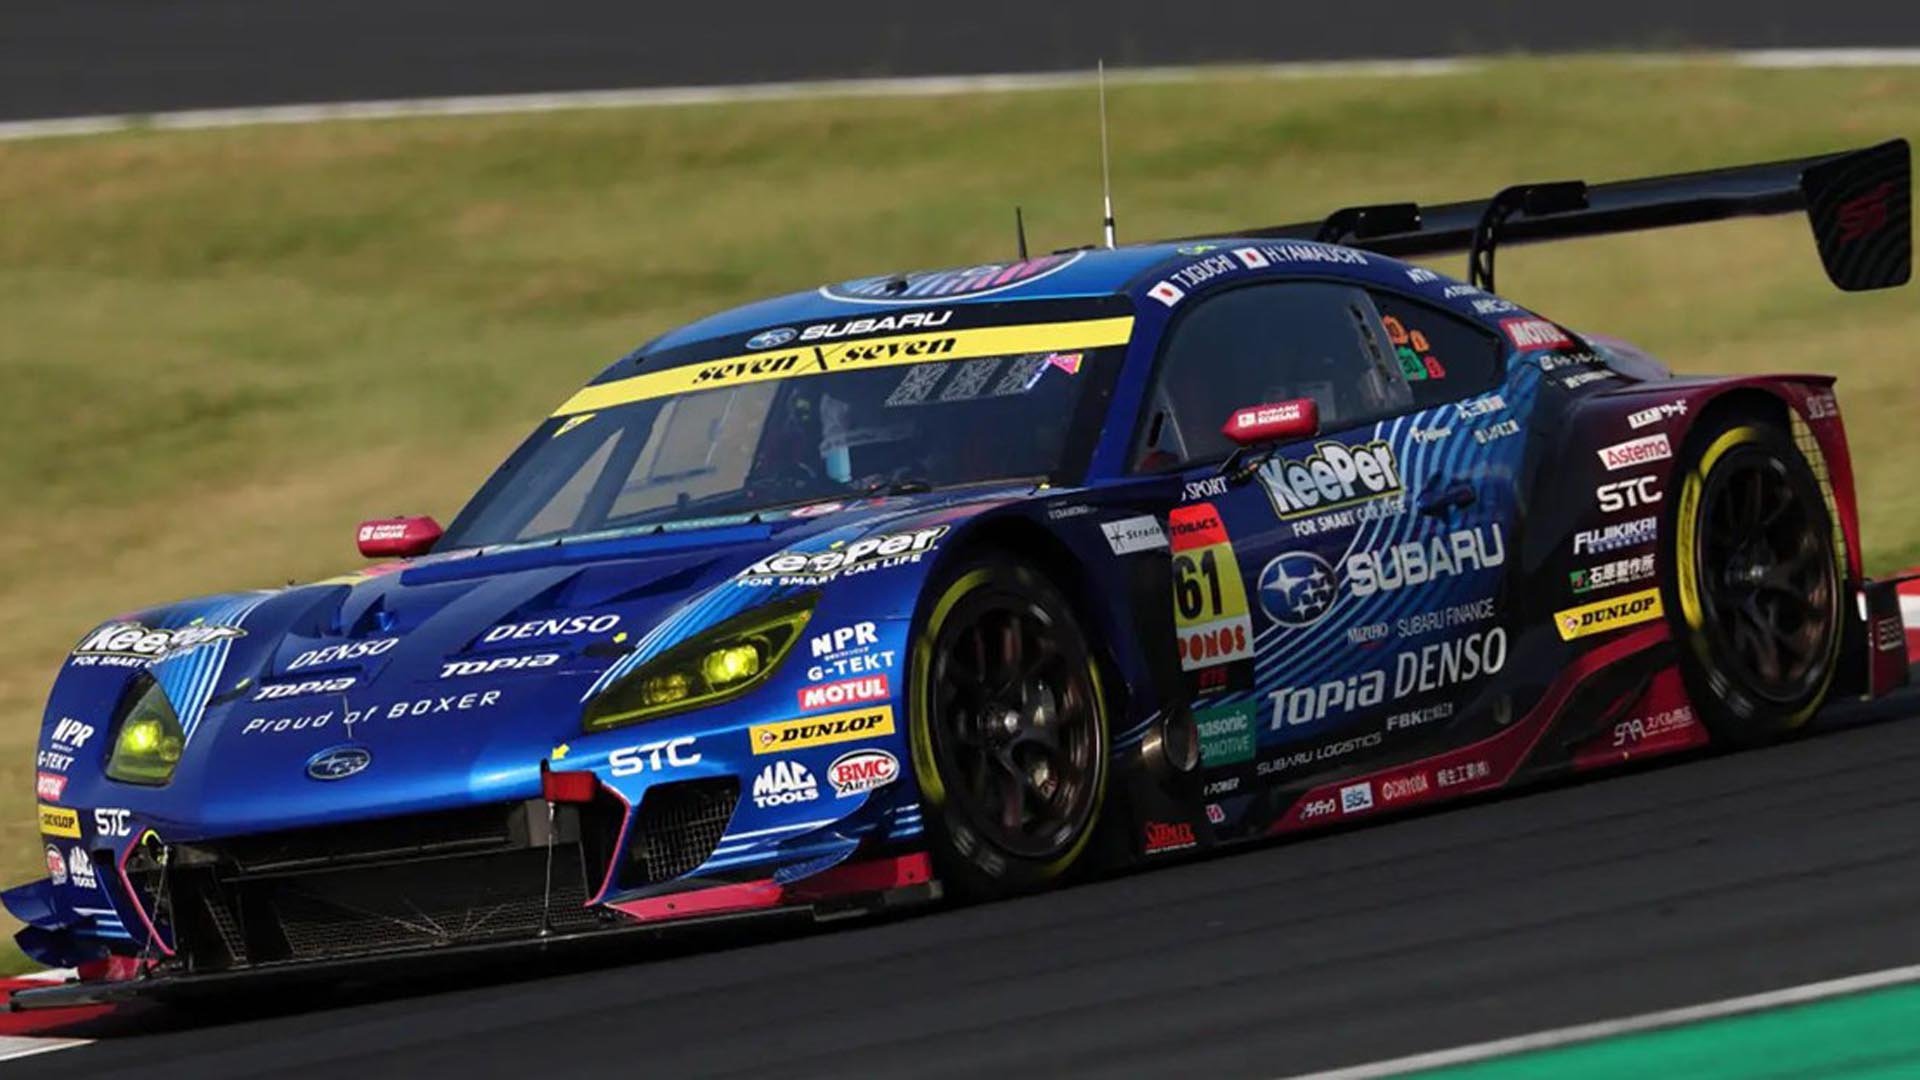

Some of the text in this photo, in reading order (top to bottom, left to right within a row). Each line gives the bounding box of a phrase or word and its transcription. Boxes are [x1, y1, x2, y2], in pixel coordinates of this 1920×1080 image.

[800, 310, 952, 341] SUBARU
[1507, 319, 1571, 348] MOTUL
[693, 354, 799, 386] seven
[840, 337, 957, 364] seven
[1606, 437, 1669, 467] Astemo
[1185, 476, 1229, 500] SPORT
[1257, 442, 1401, 516] KeePer
[1598, 475, 1663, 513] STC
[1292, 521, 1317, 538] FOR
[1319, 513, 1357, 532] SMART
[737, 525, 948, 576] KeePer
[1347, 523, 1506, 598] SUBARU
[737, 553, 922, 587] FOR SMART CAR LIFE
[1172, 549, 1224, 621] 61
[483, 614, 621, 643] DENSO
[1396, 612, 1445, 640] SUBARU
[1445, 597, 1496, 627] FINANCE
[1580, 596, 1656, 627] DUNLOP
[286, 637, 400, 672] DENSO
[810, 620, 879, 658] NPR
[1177, 623, 1247, 661] PONOS
[806, 650, 896, 681] G-TEKT
[1394, 627, 1508, 700] DENSO
[804, 678, 887, 707] MOTUL
[241, 690, 502, 735] Proud of BOXER
[780, 714, 884, 743] DUNLOP
[51, 717, 95, 748] NPR
[608, 736, 703, 778] STC
[836, 752, 890, 782] BMC
[1255, 730, 1383, 777] SUBARU LOGISTICS
[753, 760, 818, 797] MAC
[753, 787, 818, 808] TOOLS
[94, 807, 131, 837] STC
